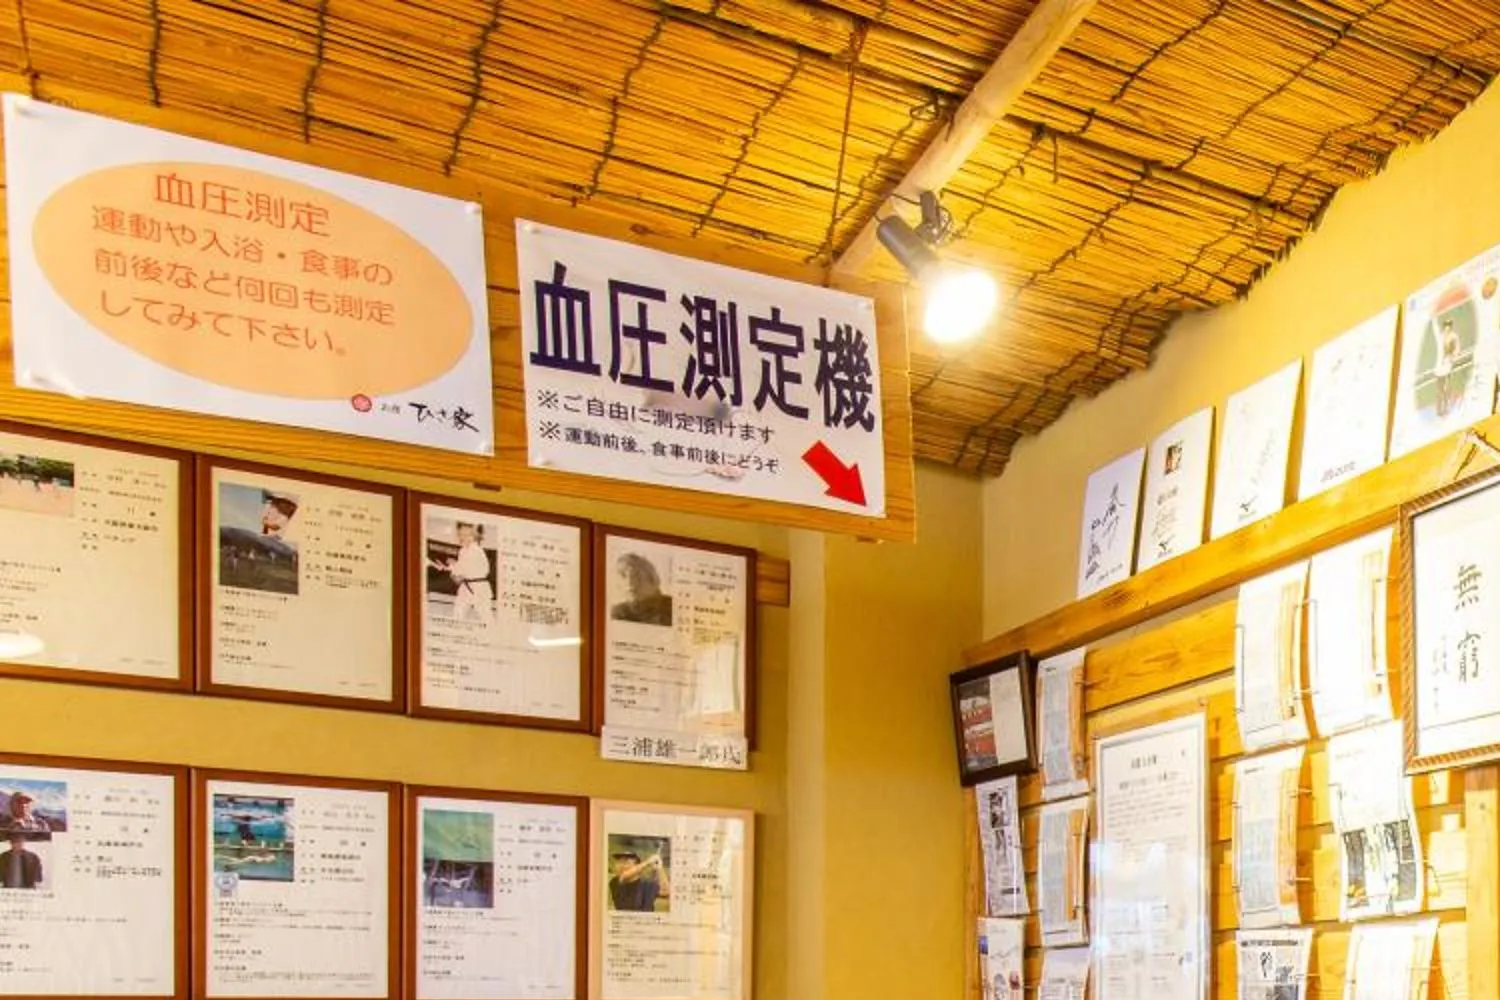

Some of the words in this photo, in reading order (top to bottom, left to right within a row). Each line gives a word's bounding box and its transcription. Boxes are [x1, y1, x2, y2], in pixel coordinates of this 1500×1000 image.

[154, 172, 332, 238] 血圧測定
[91, 204, 394, 287] 運動や入浴・食事の
[95, 248, 396, 327] 前後など何回も測定
[100, 290, 348, 357] してみて下さい。
[530, 261, 876, 433] 血圧測定機
[537, 387, 776, 446] ※ご自由に測定頂けます
[538, 420, 783, 476] ※運動前後、食事前後にどうぞ
